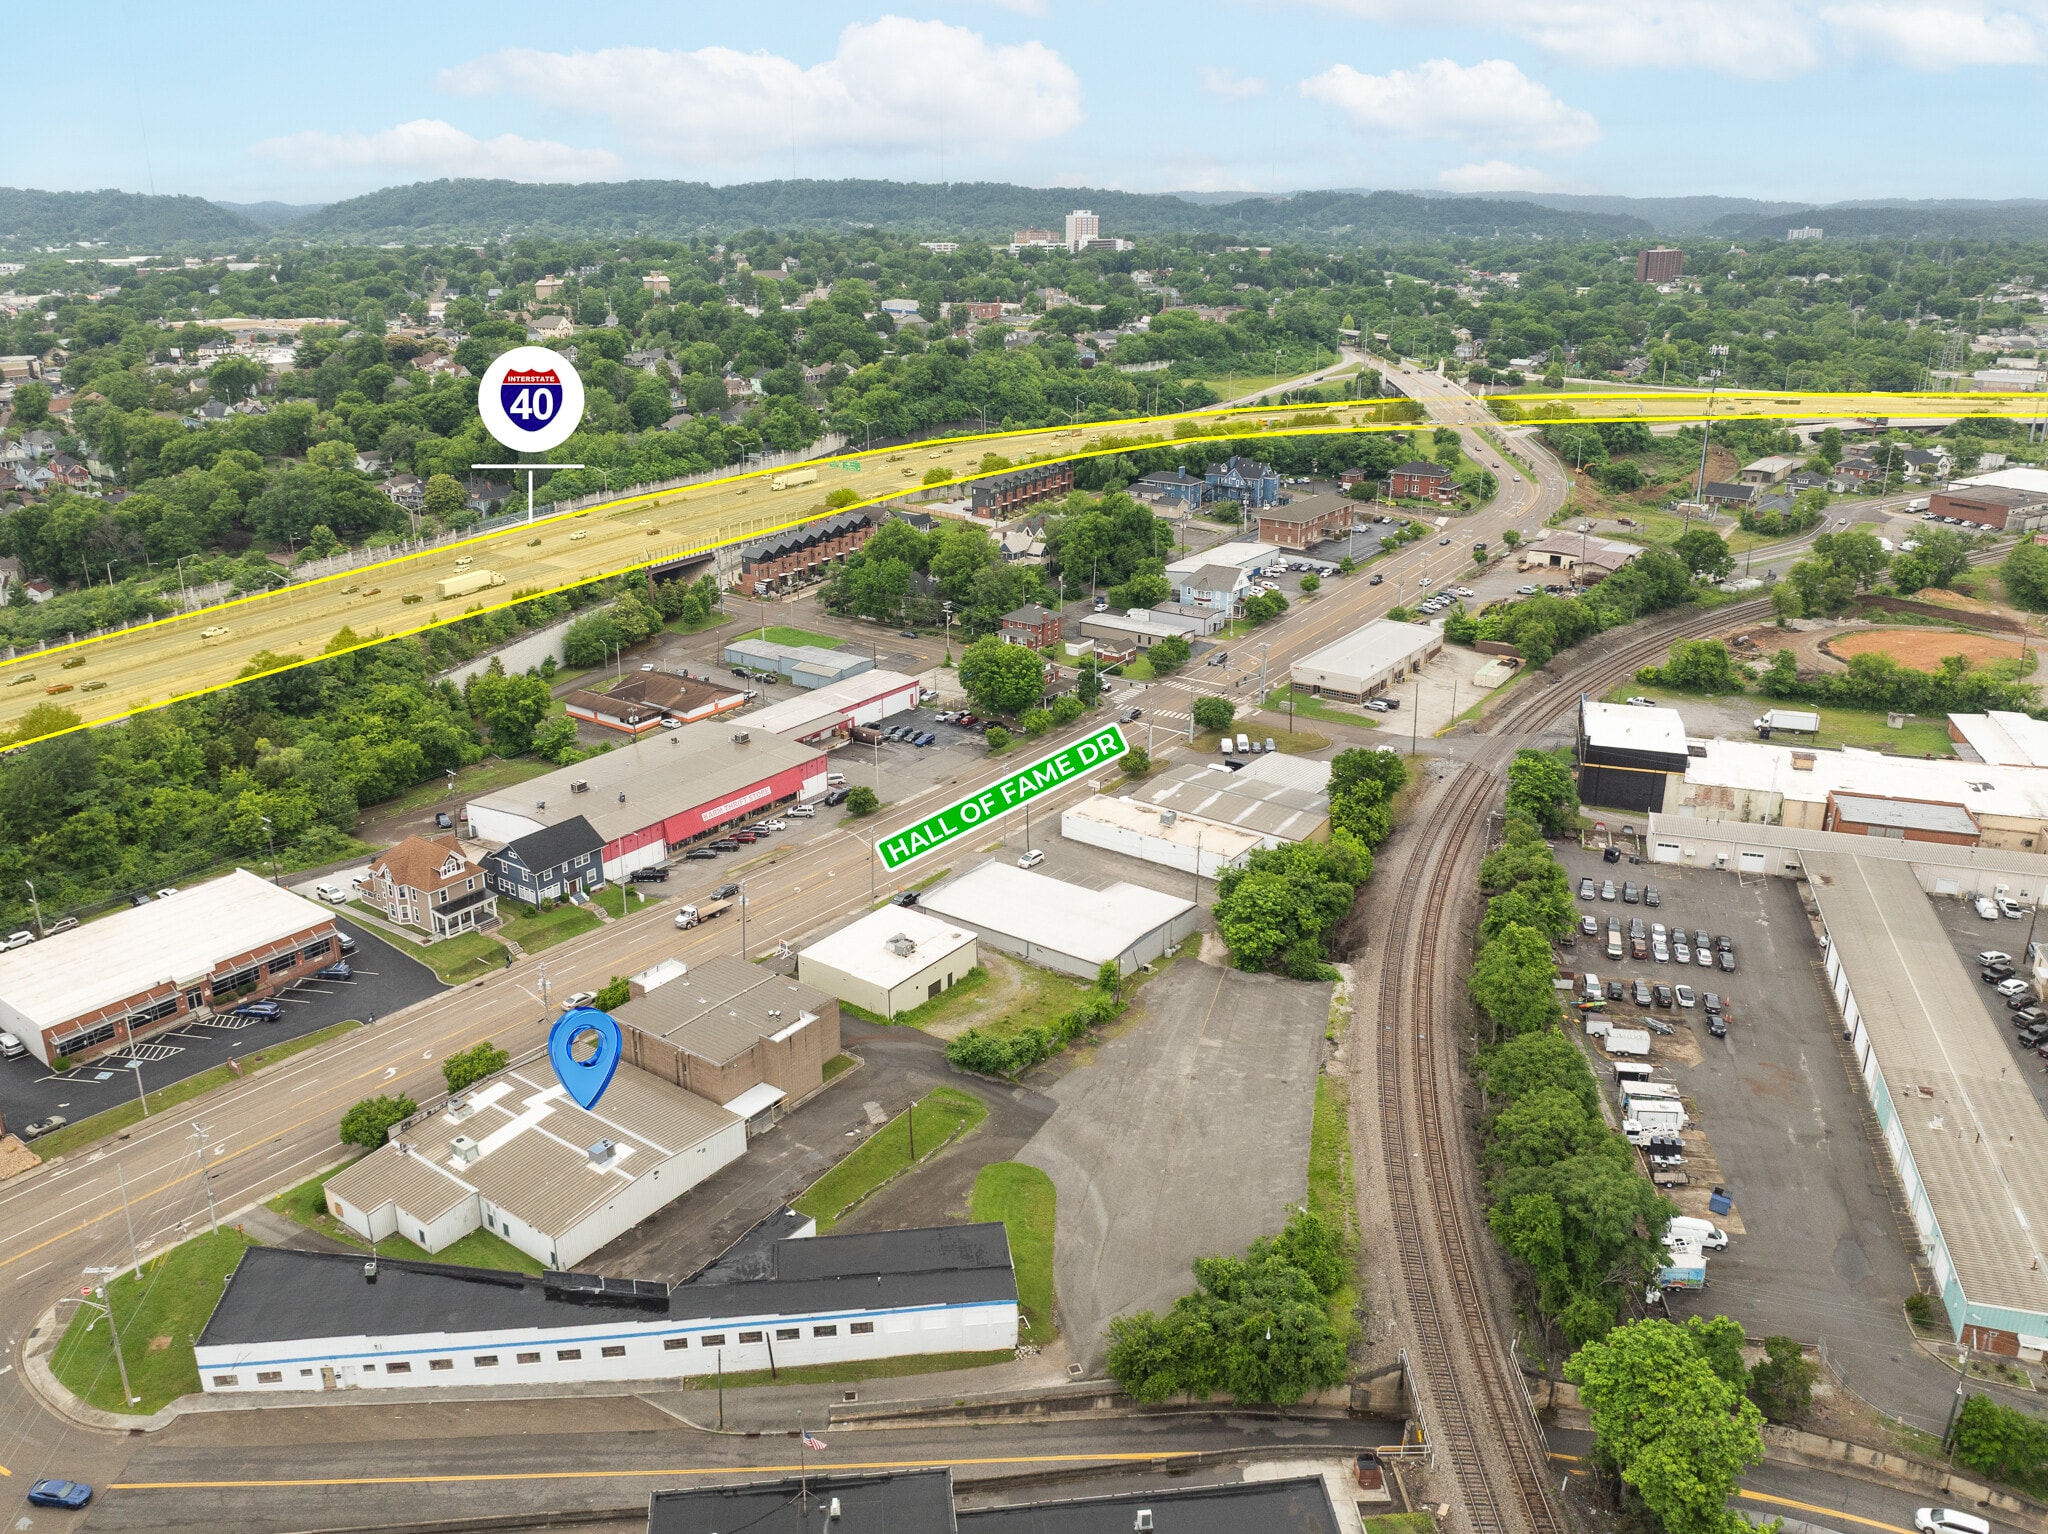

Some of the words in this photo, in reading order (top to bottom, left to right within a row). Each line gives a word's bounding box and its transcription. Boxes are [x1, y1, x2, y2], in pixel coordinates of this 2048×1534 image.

[703, 808, 723, 820] KARM
[724, 797, 747, 810] THRIFT
[749, 788, 770, 801] STORE
